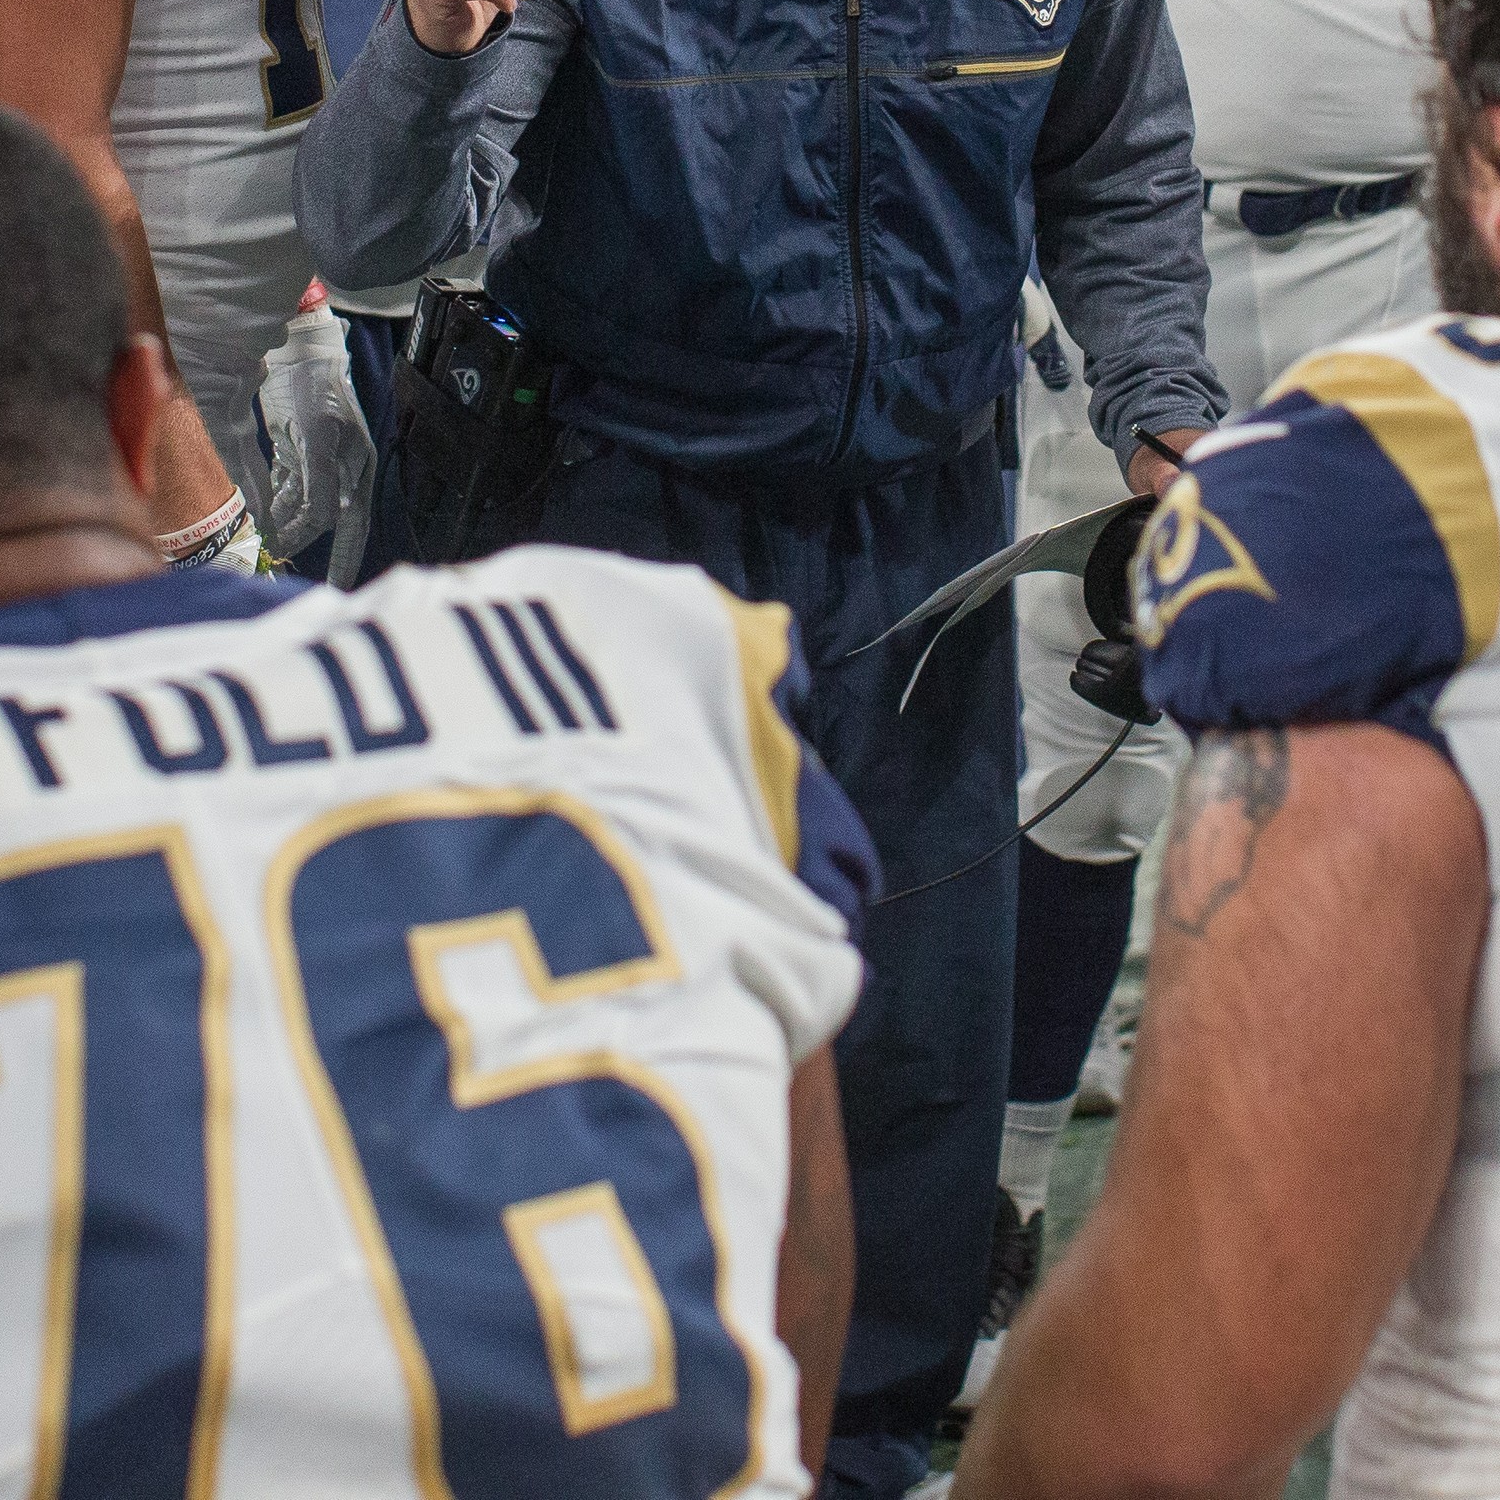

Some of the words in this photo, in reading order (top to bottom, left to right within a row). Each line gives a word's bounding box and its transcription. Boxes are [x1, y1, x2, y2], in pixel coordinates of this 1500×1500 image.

[182, 534, 191, 542] a
[192, 517, 220, 539] such
[451, 597, 622, 736] III
